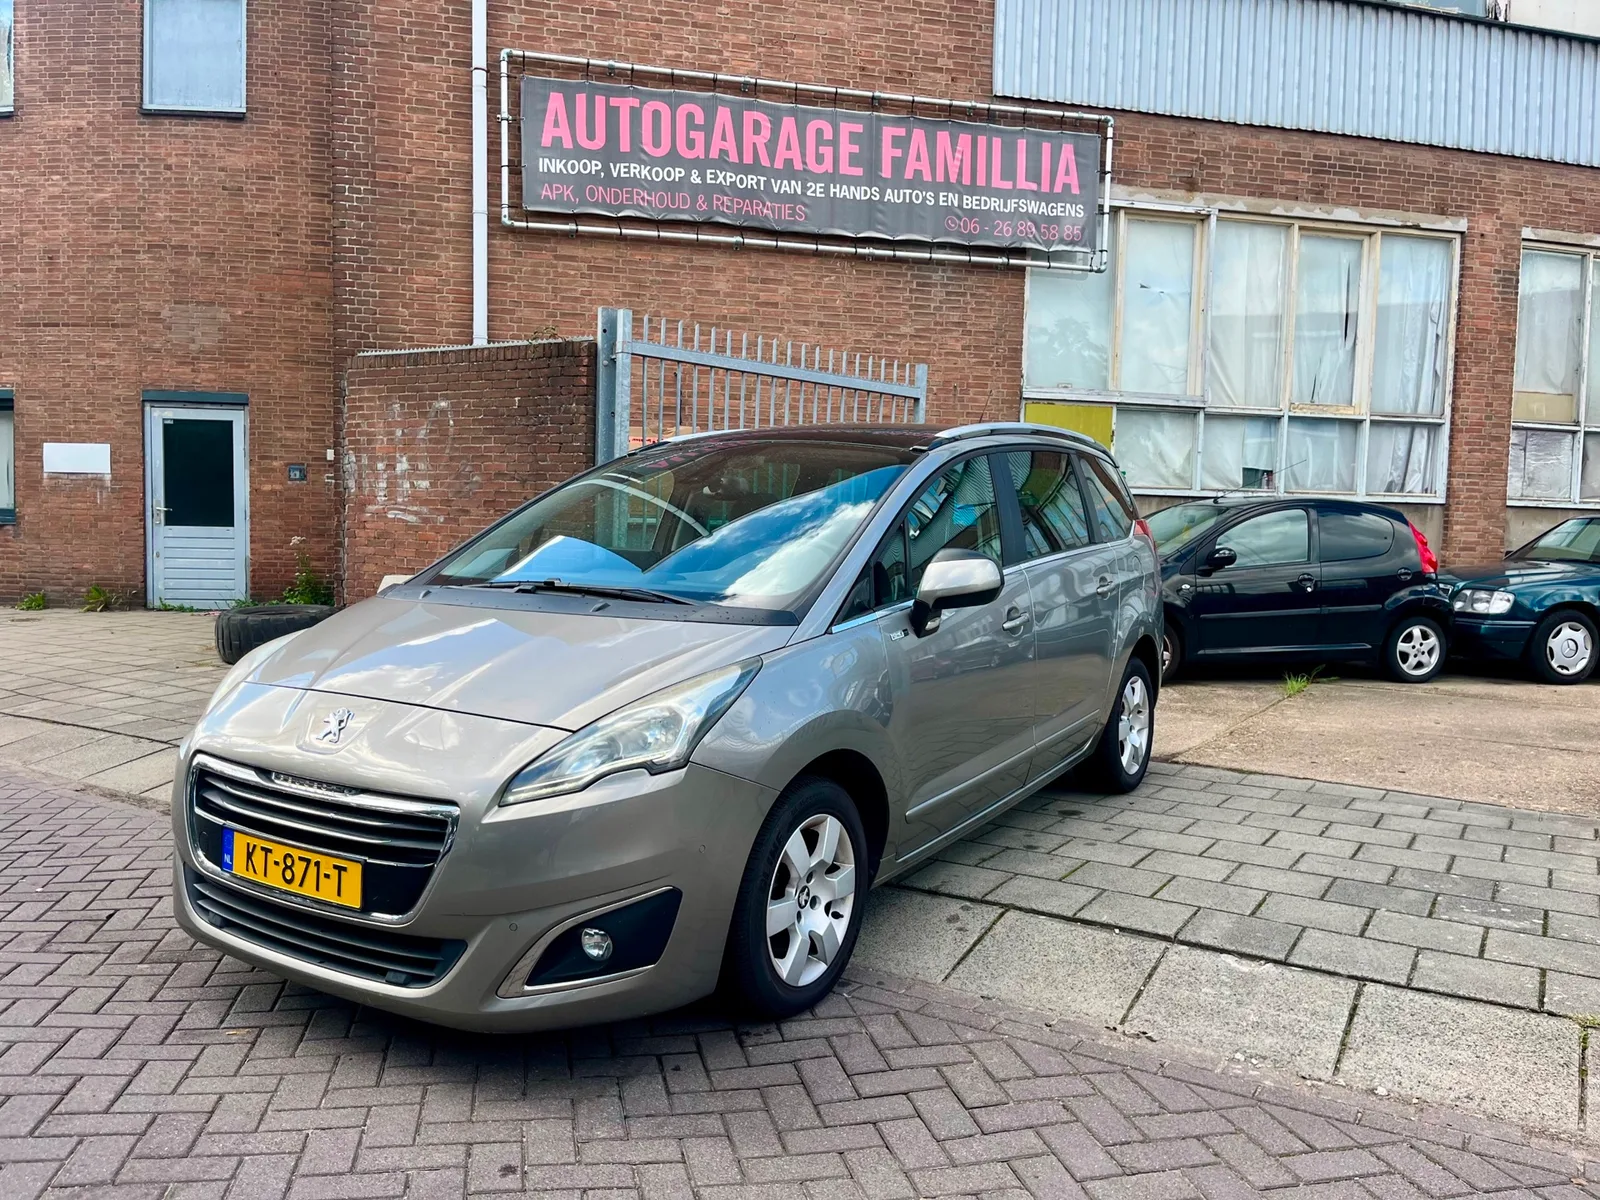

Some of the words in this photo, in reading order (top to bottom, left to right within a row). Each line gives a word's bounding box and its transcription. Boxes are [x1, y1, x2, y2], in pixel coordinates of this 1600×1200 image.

[541, 91, 864, 176] AUTOGARAGE
[881, 125, 1080, 195] FAMILLIA
[538, 157, 605, 178] INKOOP,
[609, 162, 686, 182] VERKOOP
[690, 169, 702, 184] &
[706, 169, 767, 191] EXPORT
[770, 178, 802, 195] VAN
[806, 182, 825, 198] 2E
[829, 183, 880, 201] HANDS
[884, 188, 935, 206] AUTO'S
[939, 192, 959, 207] EN
[962, 195, 1085, 218] BEDRIJFSWAGENS
[541, 183, 579, 205] APK,
[585, 184, 691, 210] ONDERHOUD
[696, 194, 708, 211] &
[713, 193, 806, 221] REPARATIES
[960, 217, 980, 234] 06
[993, 220, 1012, 237] 26
[1016, 221, 1036, 237] 89
[1040, 224, 1059, 240] 58
[1063, 224, 1082, 241] 85
[223, 853, 233, 865] NL
[245, 841, 348, 897] KT-871-T
